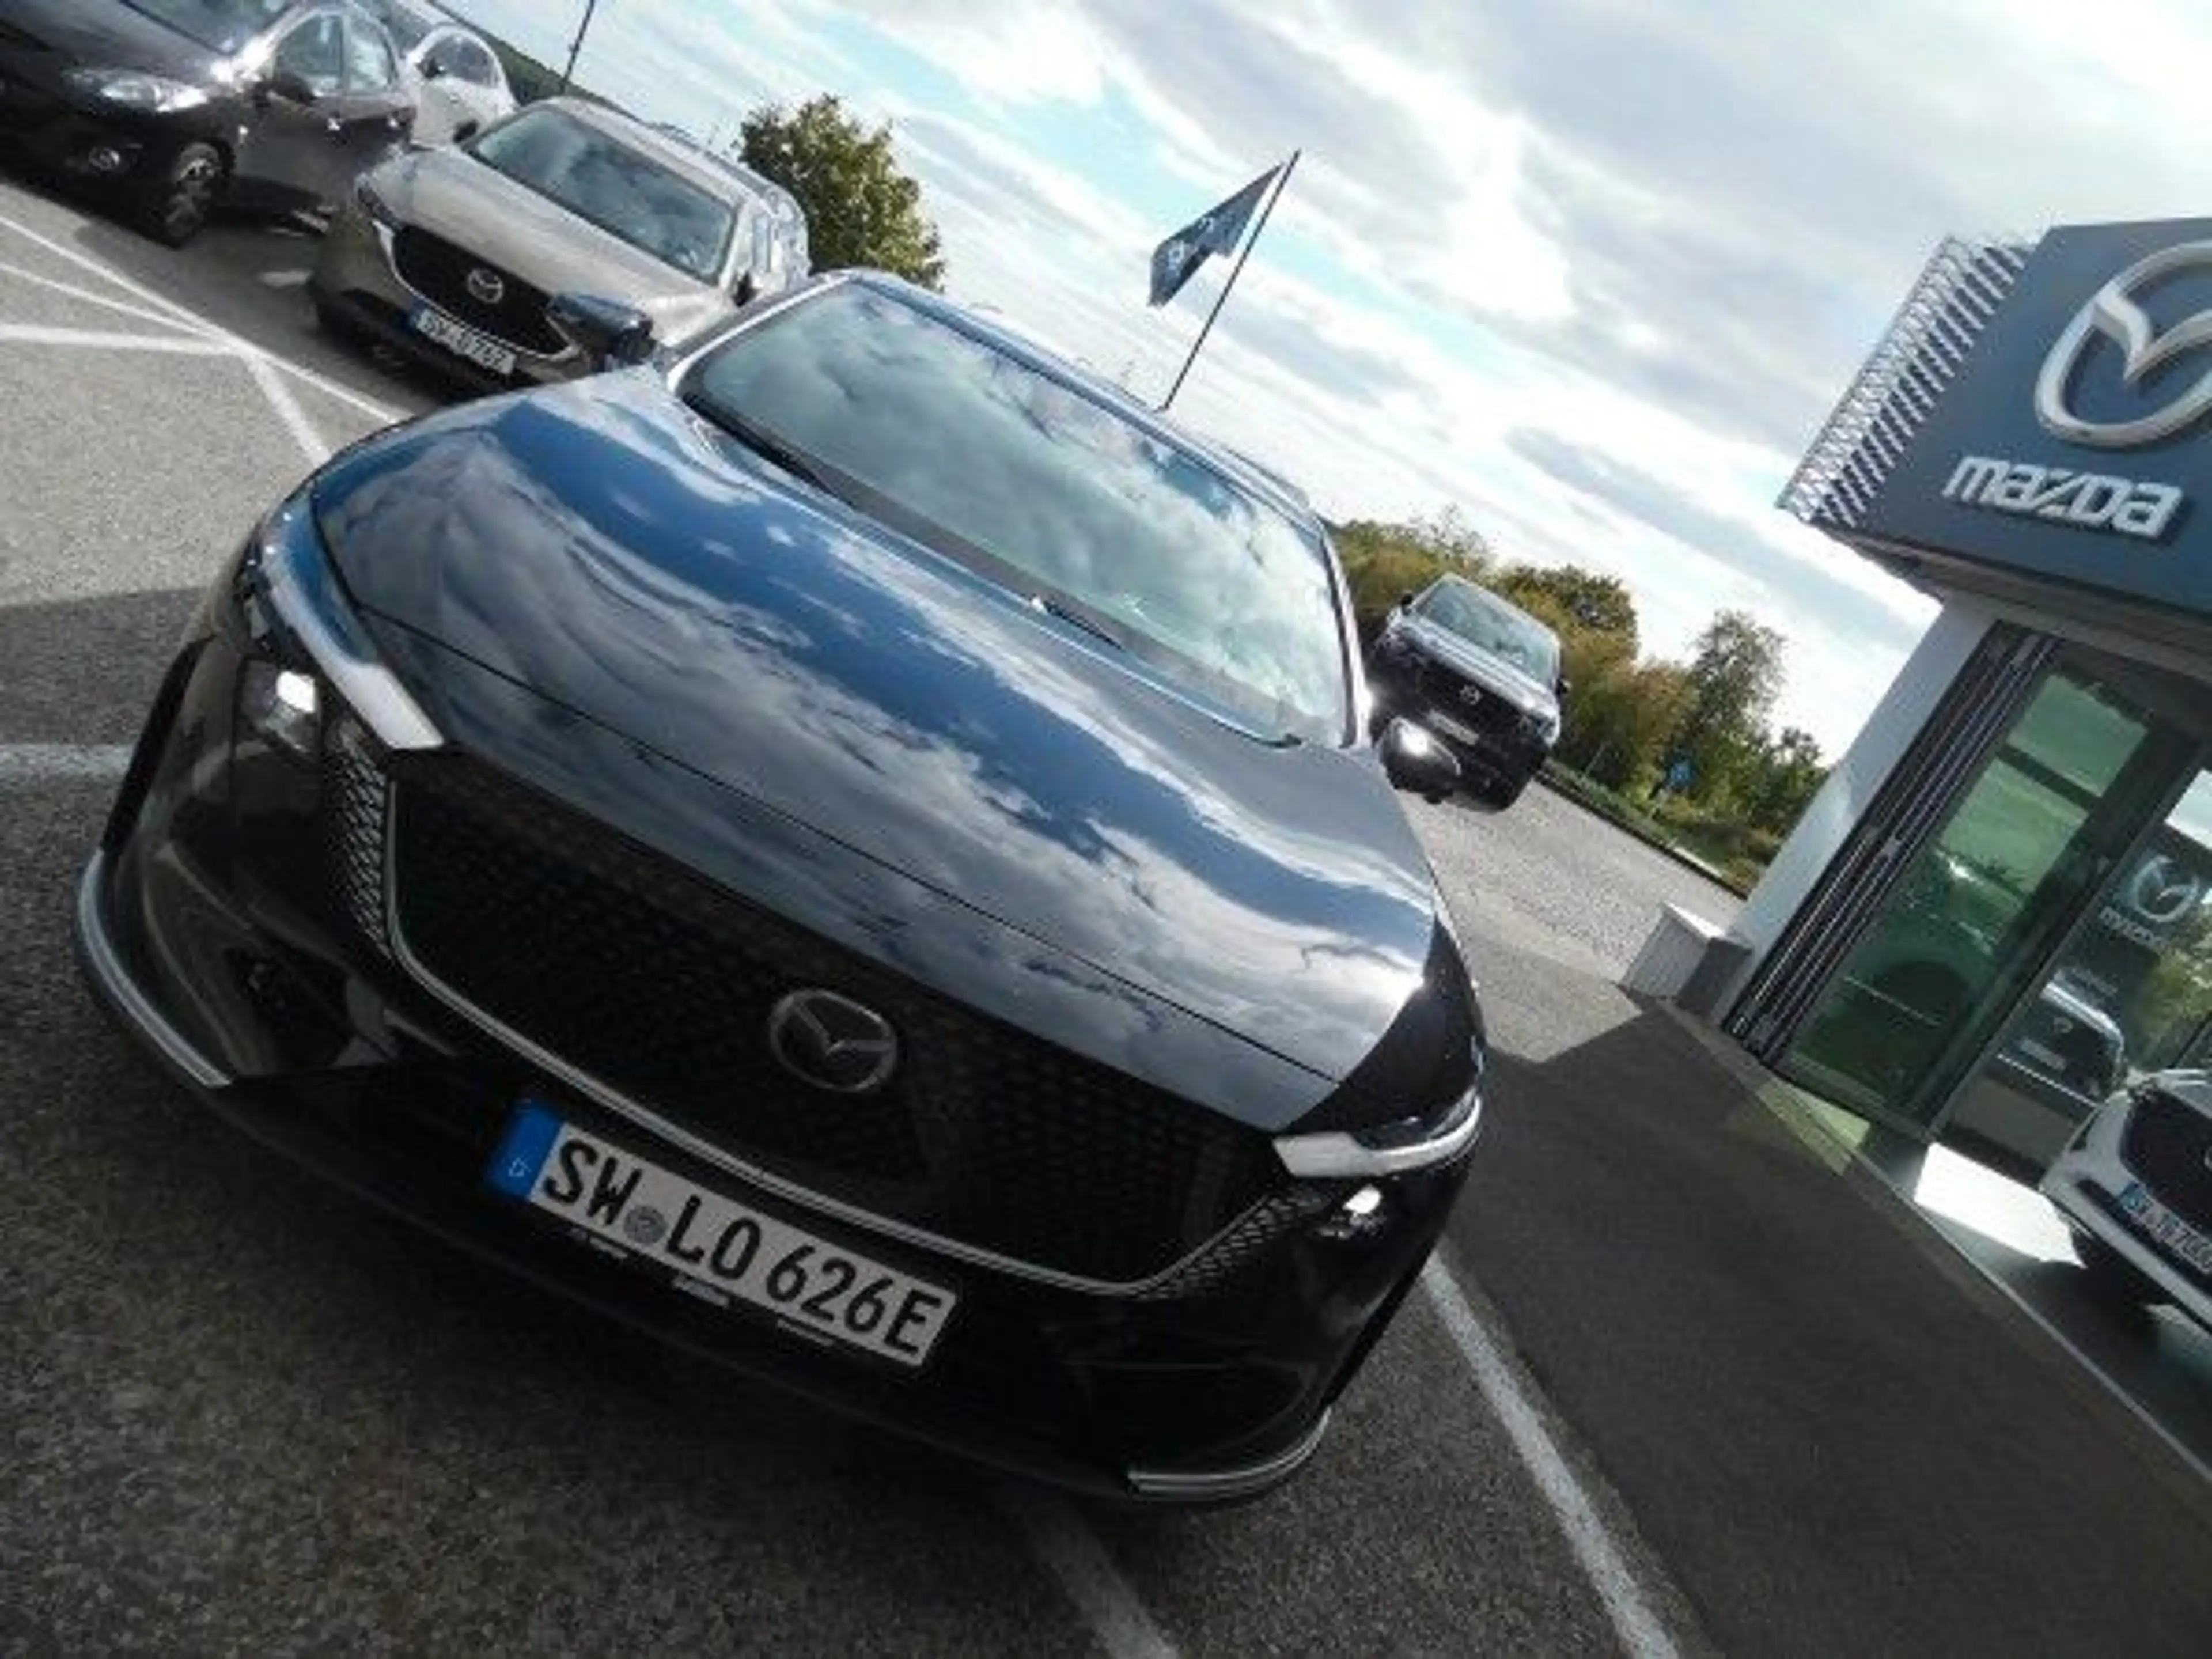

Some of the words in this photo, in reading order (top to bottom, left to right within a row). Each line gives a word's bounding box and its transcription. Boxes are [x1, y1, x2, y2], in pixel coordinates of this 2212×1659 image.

[543, 1139, 642, 1226] SW
[666, 1194, 761, 1281] LO
[766, 1244, 942, 1354] 626E
